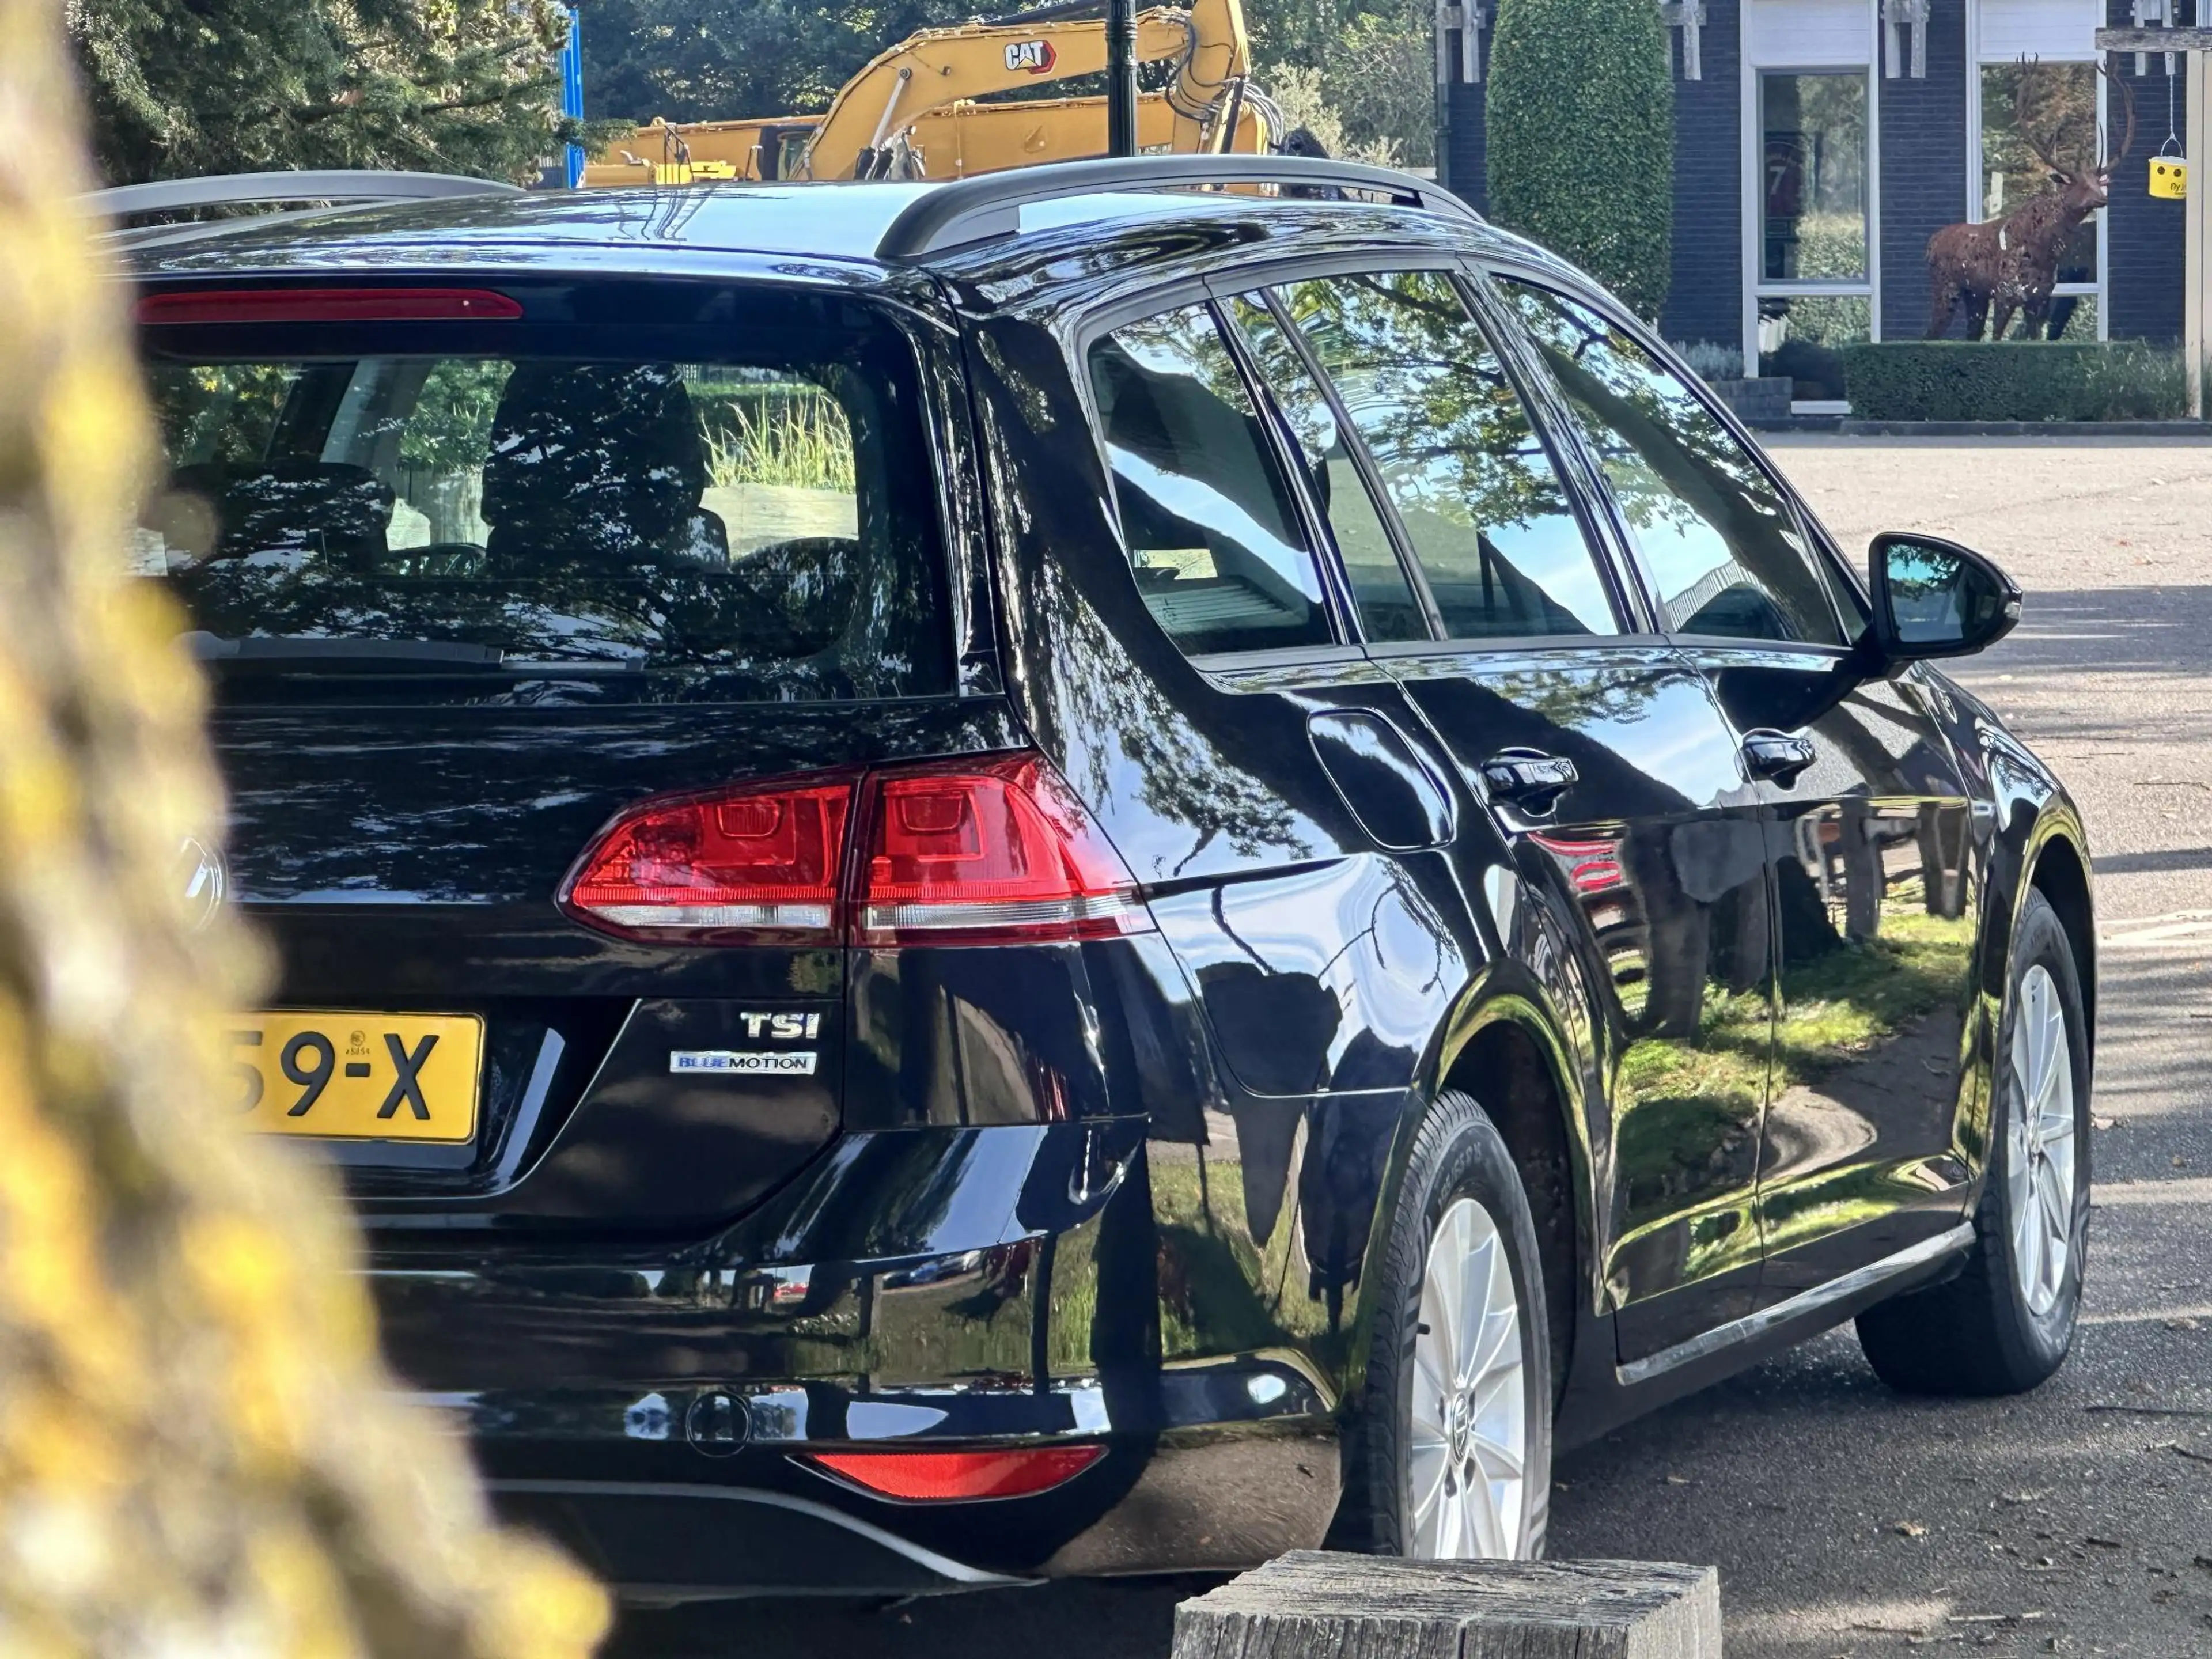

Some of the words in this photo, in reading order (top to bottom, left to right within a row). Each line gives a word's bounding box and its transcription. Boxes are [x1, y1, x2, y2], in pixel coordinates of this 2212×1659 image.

[1005, 41, 1044, 70] CAT
[1769, 165, 1787, 195] 7
[740, 1012, 820, 1039] TSI
[678, 1056, 807, 1069] BLUEMOTION
